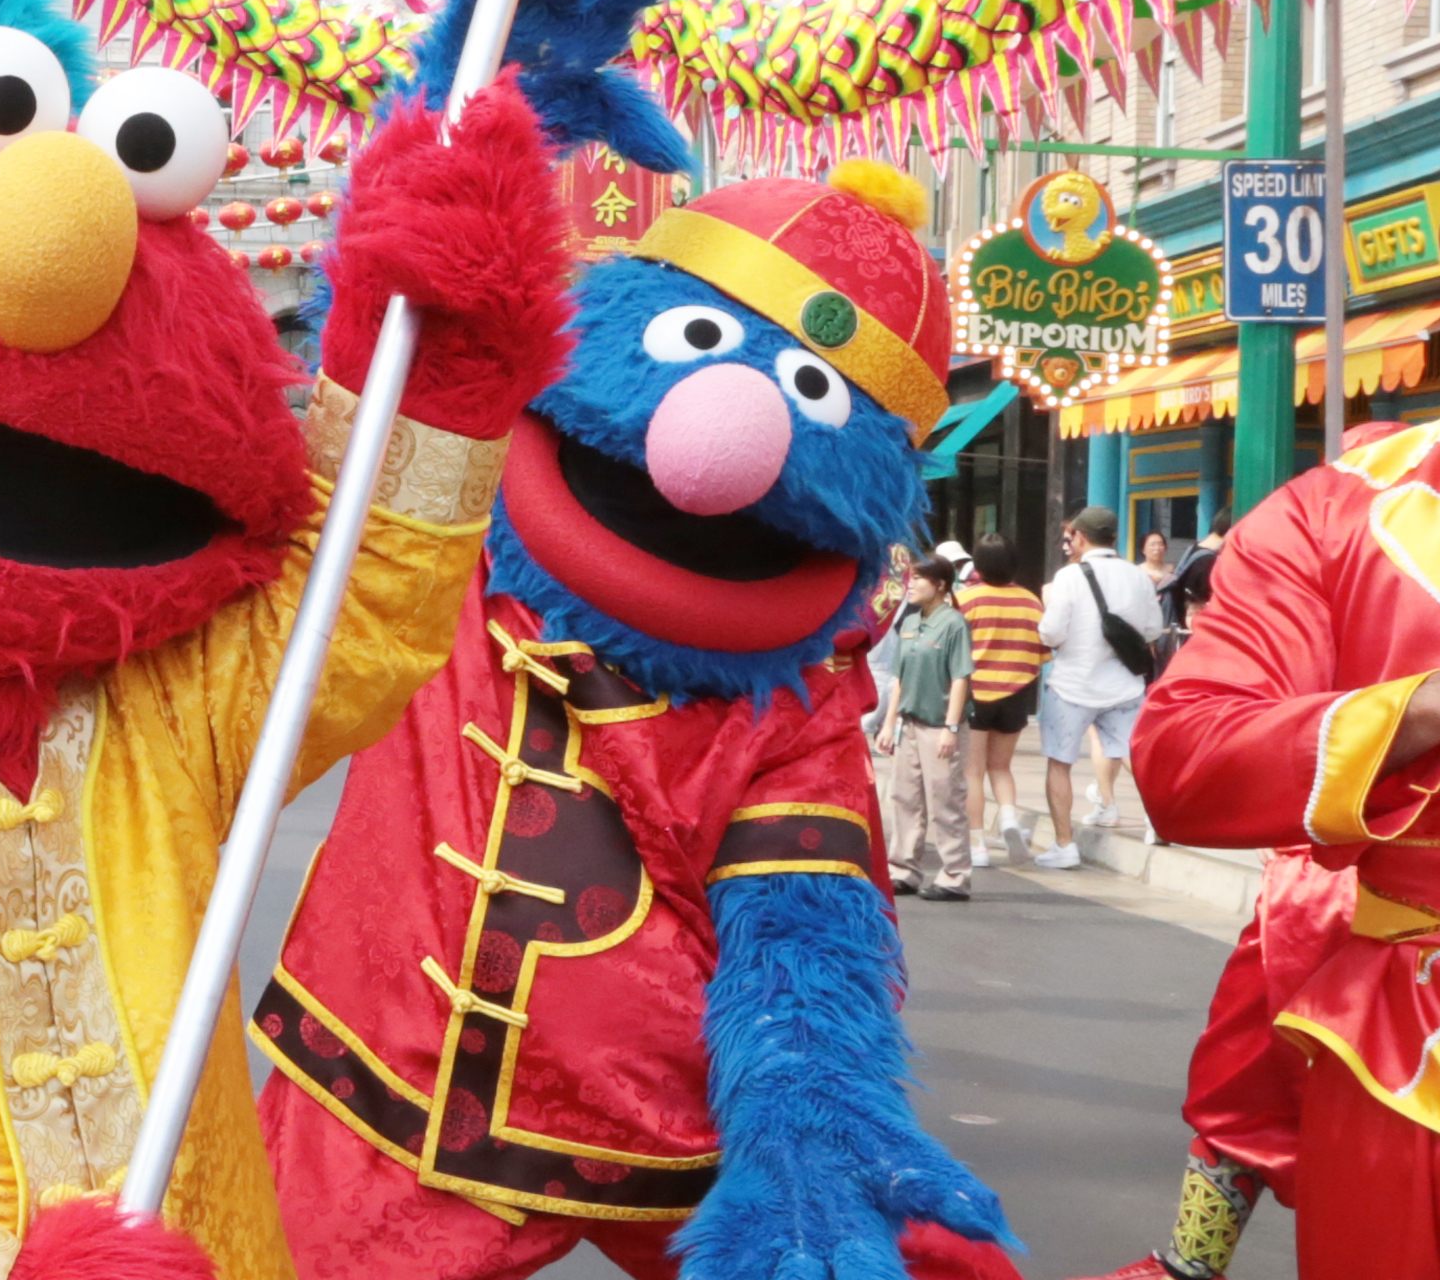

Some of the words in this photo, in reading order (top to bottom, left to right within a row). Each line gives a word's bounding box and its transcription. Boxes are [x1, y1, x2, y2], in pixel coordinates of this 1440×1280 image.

[1232, 173, 1287, 197] SPEED
[1291, 173, 1326, 197] LIMI
[1244, 204, 1324, 275] 30
[1357, 216, 1425, 266] GIFTS
[1262, 283, 1307, 308] MILES
[968, 314, 1157, 355] EMPORIUM
